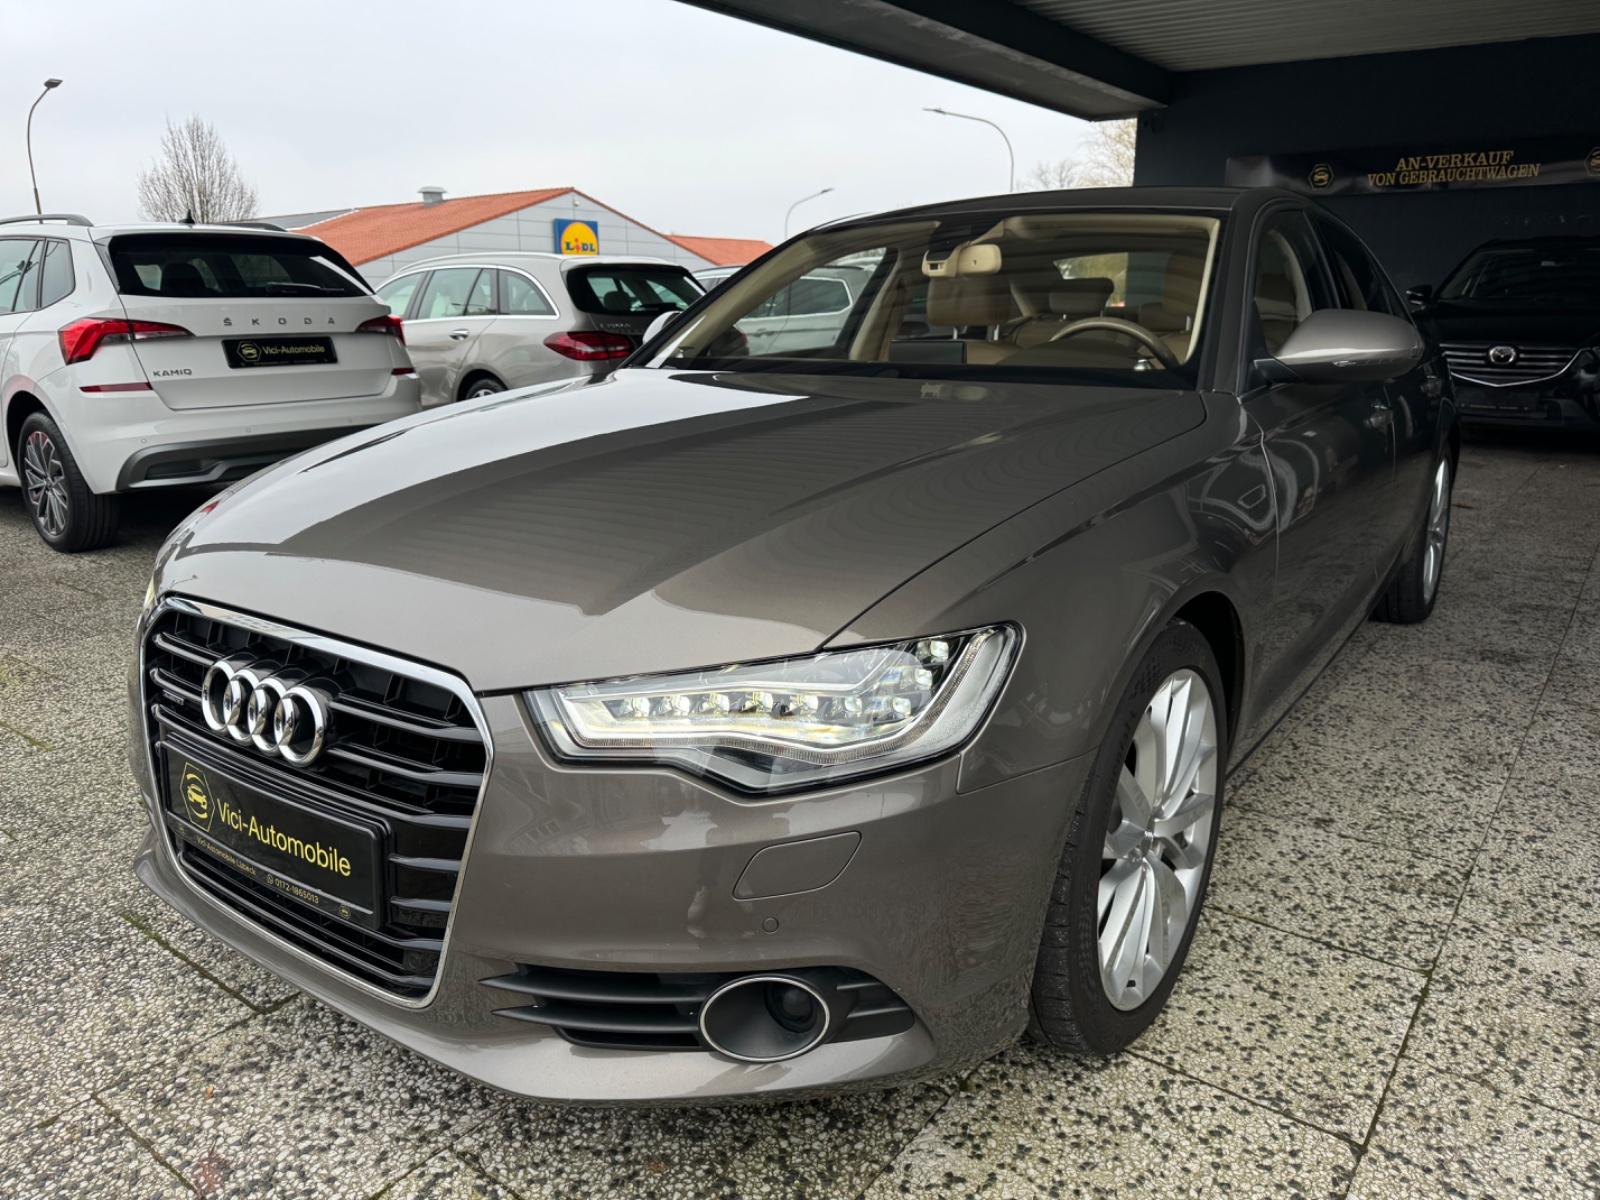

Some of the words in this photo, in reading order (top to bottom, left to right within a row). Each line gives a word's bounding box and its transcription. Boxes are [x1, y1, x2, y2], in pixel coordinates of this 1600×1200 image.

[1396, 151, 1514, 171] AN-VERKAUF
[1368, 173, 1396, 186] VON
[1400, 163, 1541, 184] GEBRAUCHTWAGEN
[261, 343, 326, 354] Vici-Automobile
[153, 368, 193, 377] KAMIQ
[217, 798, 351, 877] Vici-Automobile
